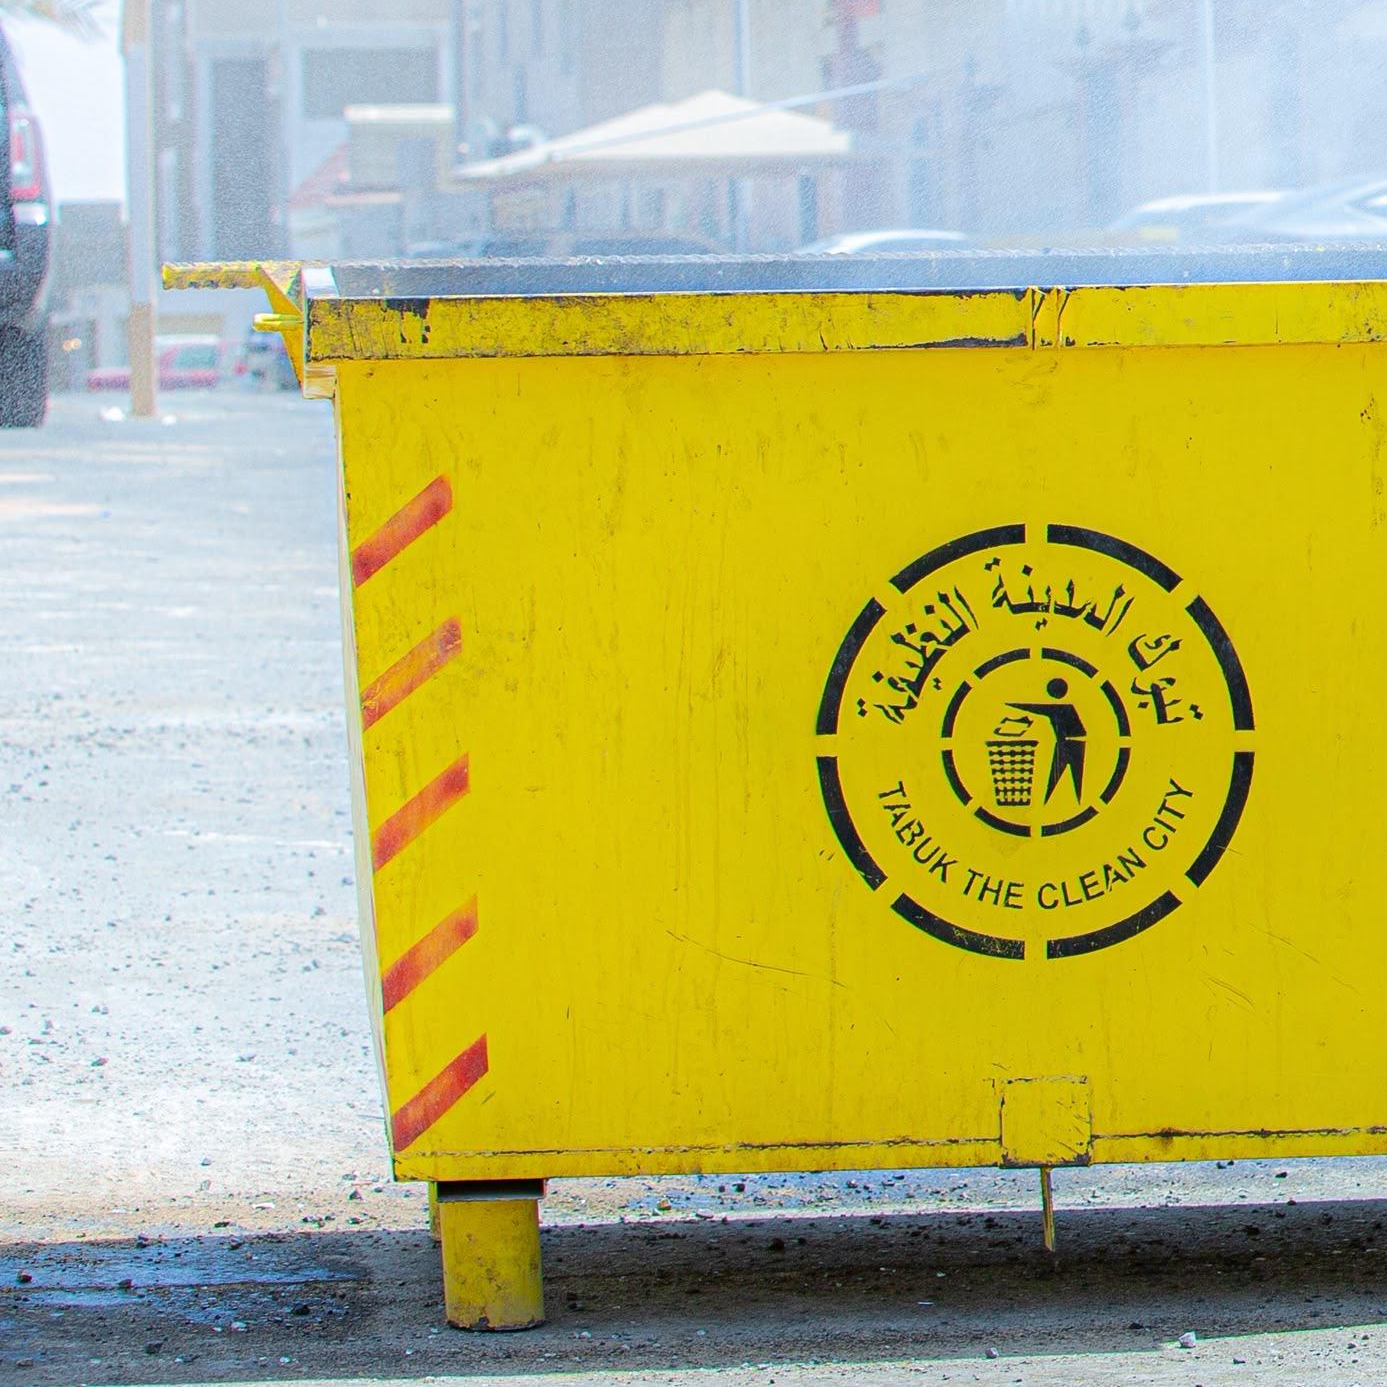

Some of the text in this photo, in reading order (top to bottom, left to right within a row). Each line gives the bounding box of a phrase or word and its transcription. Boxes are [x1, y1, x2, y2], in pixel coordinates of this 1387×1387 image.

[856, 556, 1204, 726] تبوك المدينة النظيفة
[877, 778, 1194, 911] TABUK THE CLEAN CITY
